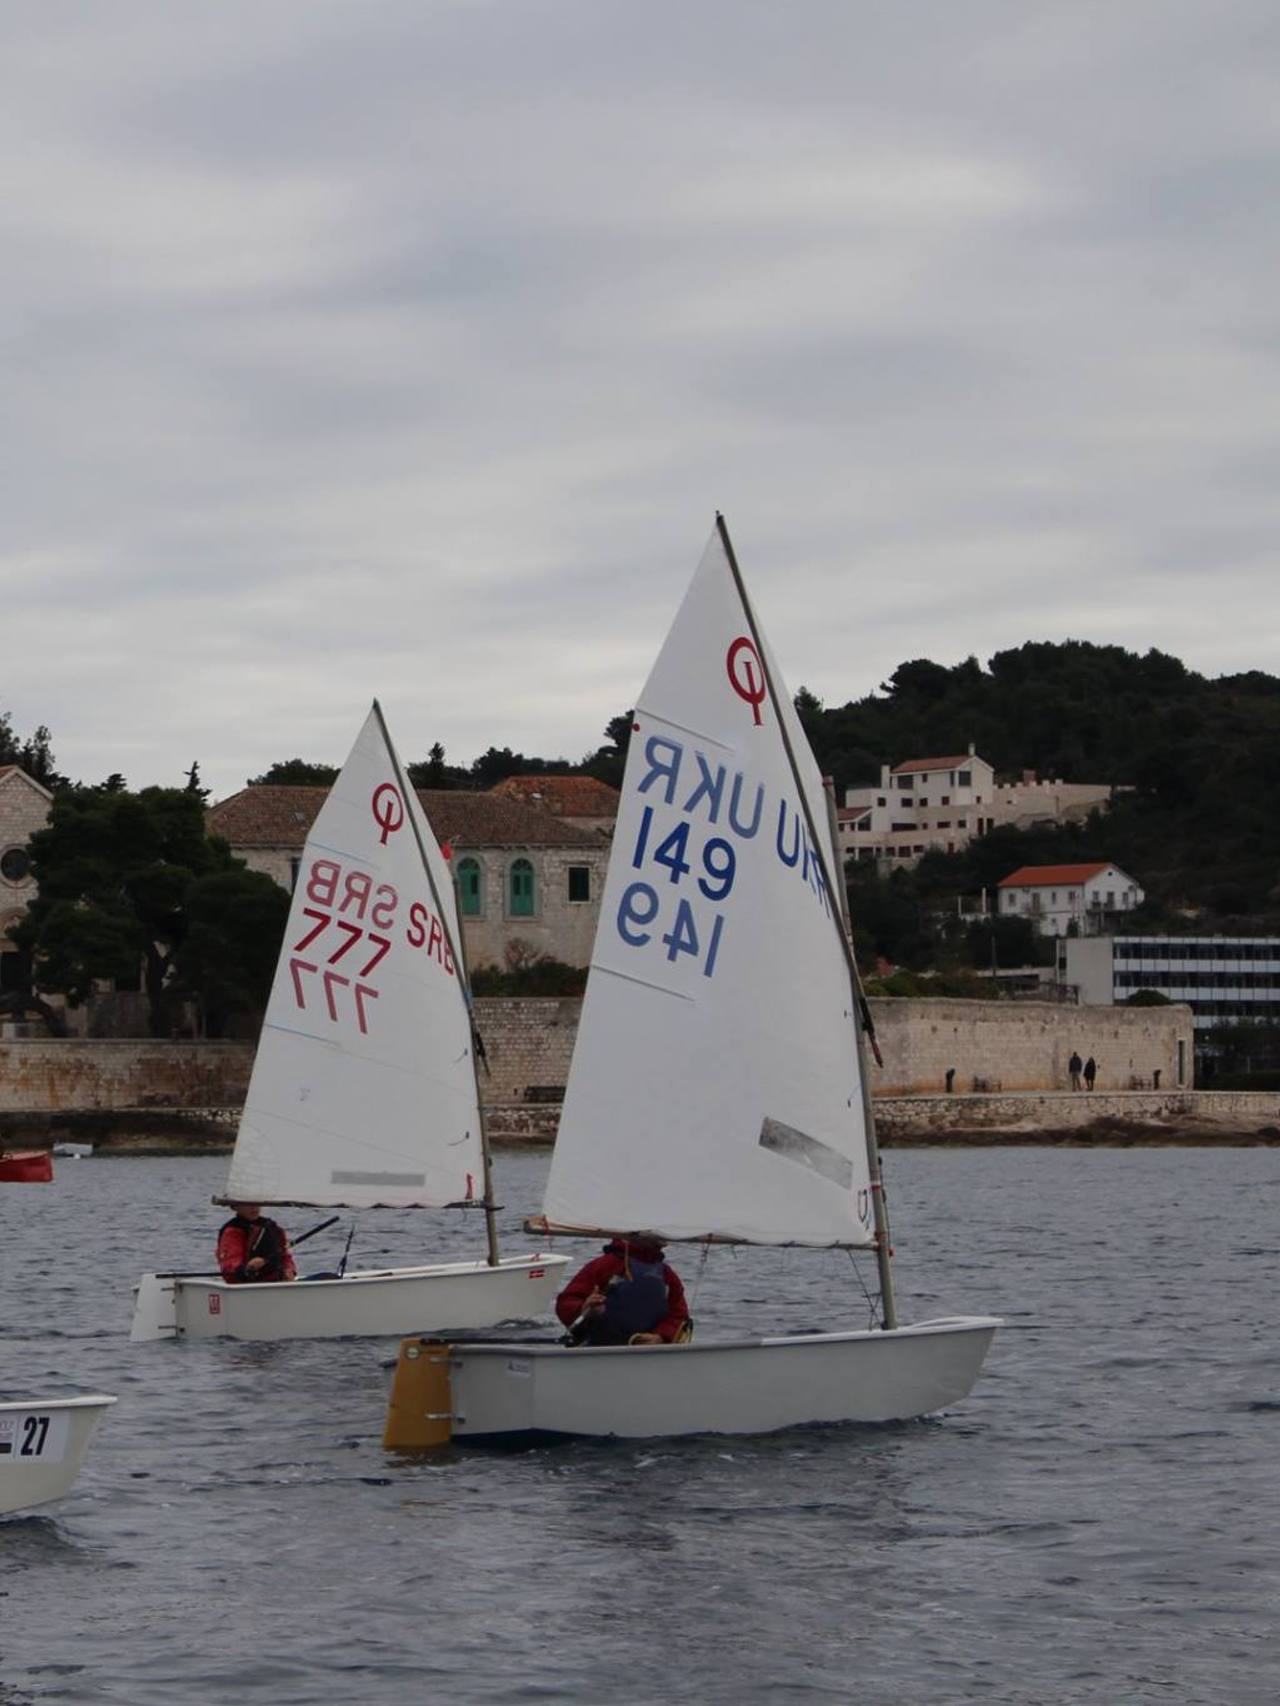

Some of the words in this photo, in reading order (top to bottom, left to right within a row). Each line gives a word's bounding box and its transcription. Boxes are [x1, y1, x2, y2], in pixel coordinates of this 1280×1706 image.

[633, 806, 736, 901] 149
[294, 908, 391, 977] 777
[21, 1416, 49, 1456] 27
